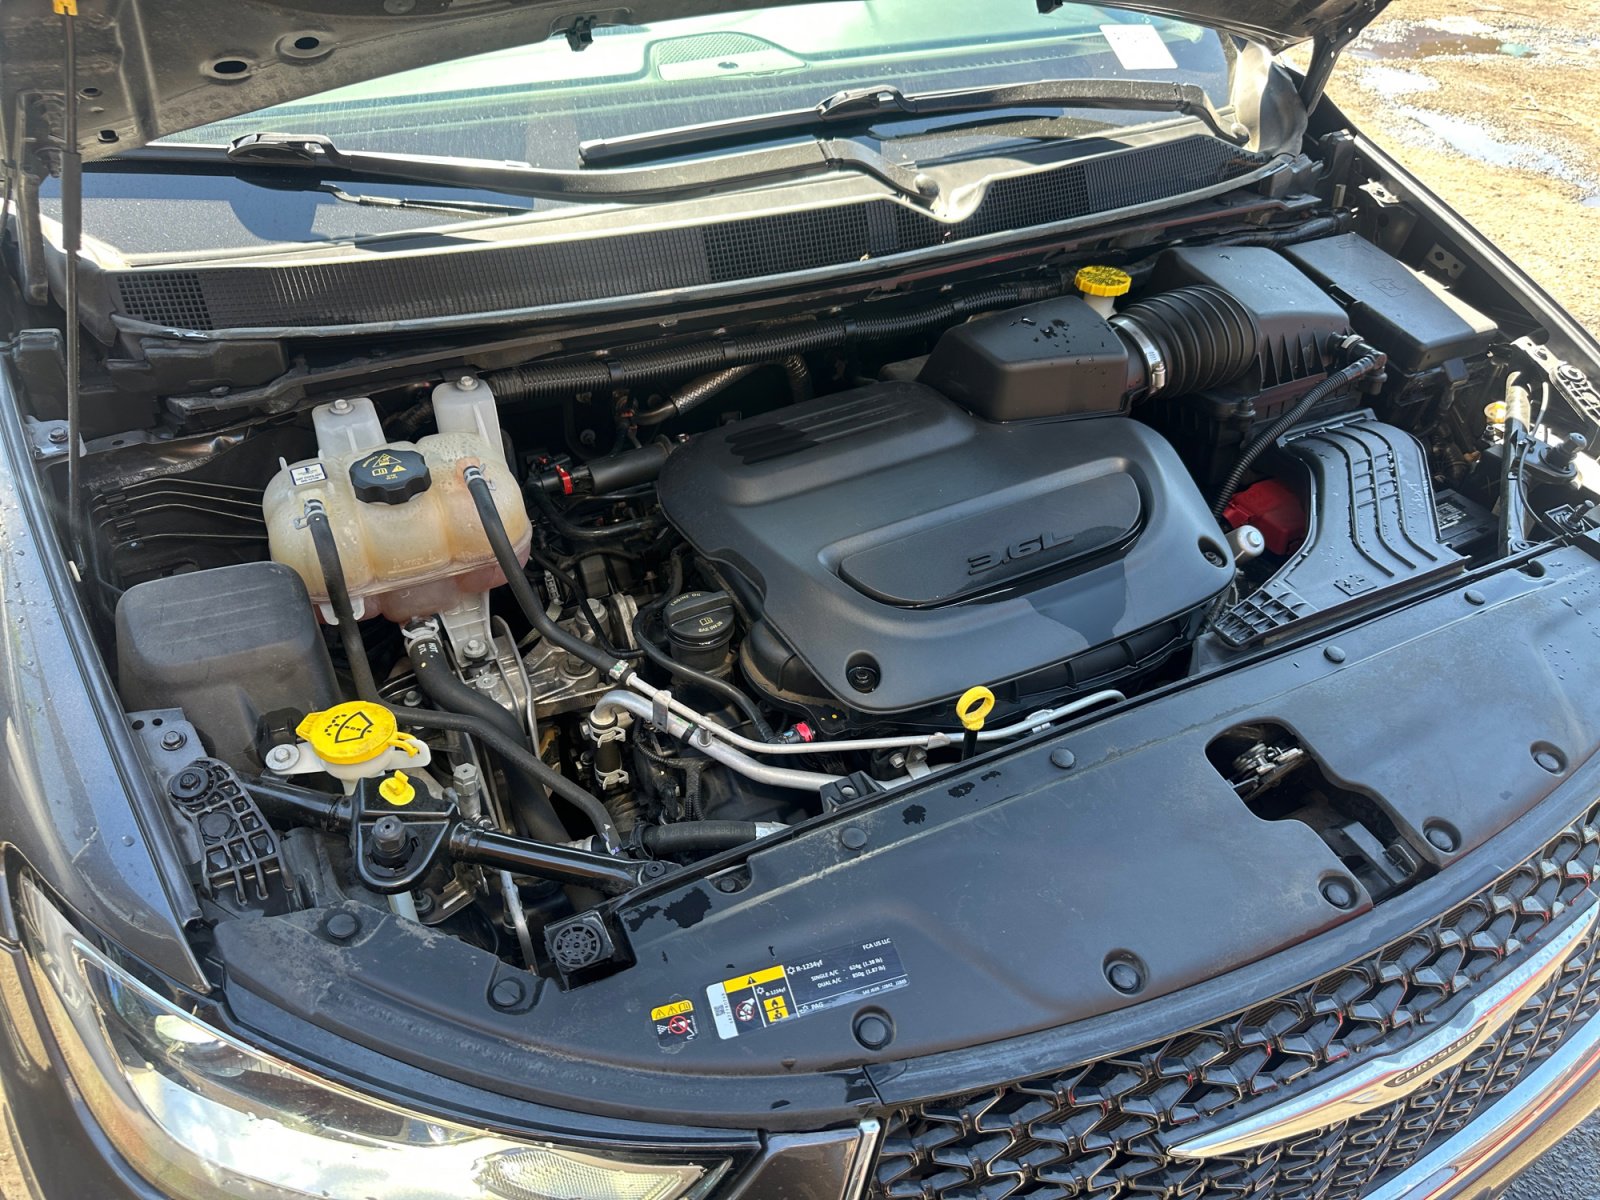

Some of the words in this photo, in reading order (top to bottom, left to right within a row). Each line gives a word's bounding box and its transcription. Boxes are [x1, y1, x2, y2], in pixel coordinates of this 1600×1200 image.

[966, 530, 1075, 576] 3.6L
[862, 943, 873, 951] FCA
[881, 937, 891, 945] LLC
[795, 959, 823, 973] R-1234yf
[811, 972, 829, 982] SINGLE
[829, 969, 840, 977] A/C
[817, 980, 832, 989] DUAL
[831, 977, 842, 985] A/C
[811, 1001, 824, 1010] PAG
[1394, 1031, 1476, 1084] CHRYSLER
